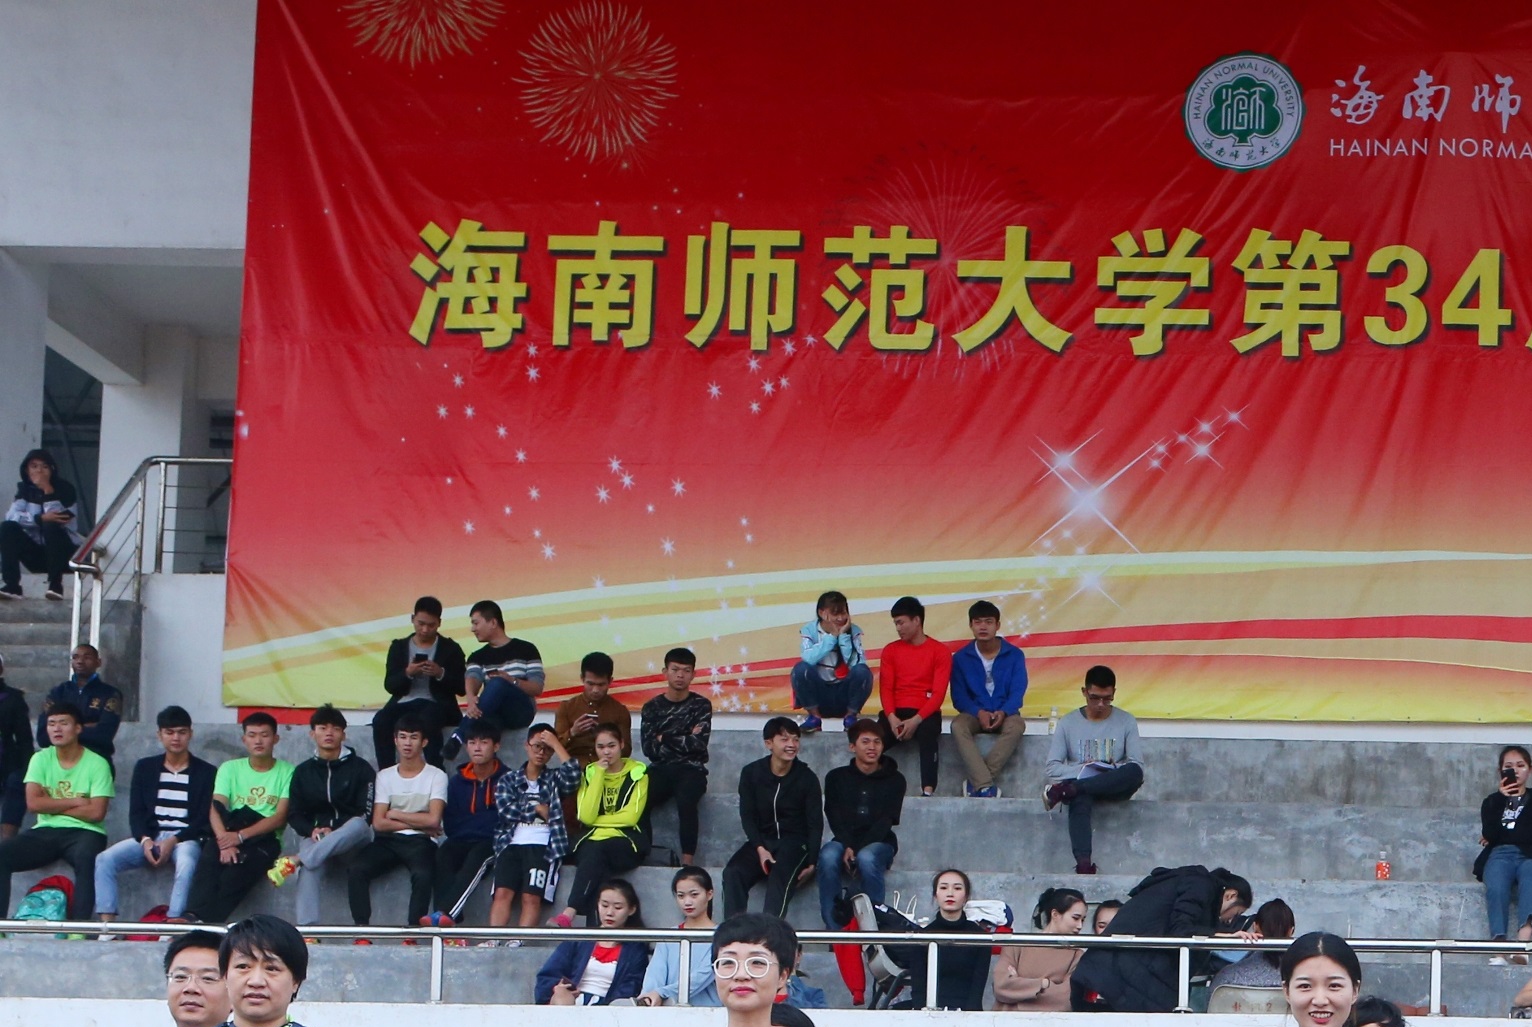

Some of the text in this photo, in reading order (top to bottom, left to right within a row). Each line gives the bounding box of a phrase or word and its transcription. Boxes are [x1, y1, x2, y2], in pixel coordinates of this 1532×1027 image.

[1214, 62, 1259, 80] NORMAL
[1262, 66, 1295, 118] UNIVERSITY
[1329, 137, 1429, 157] HAINAN
[529, 868, 547, 888] 18
